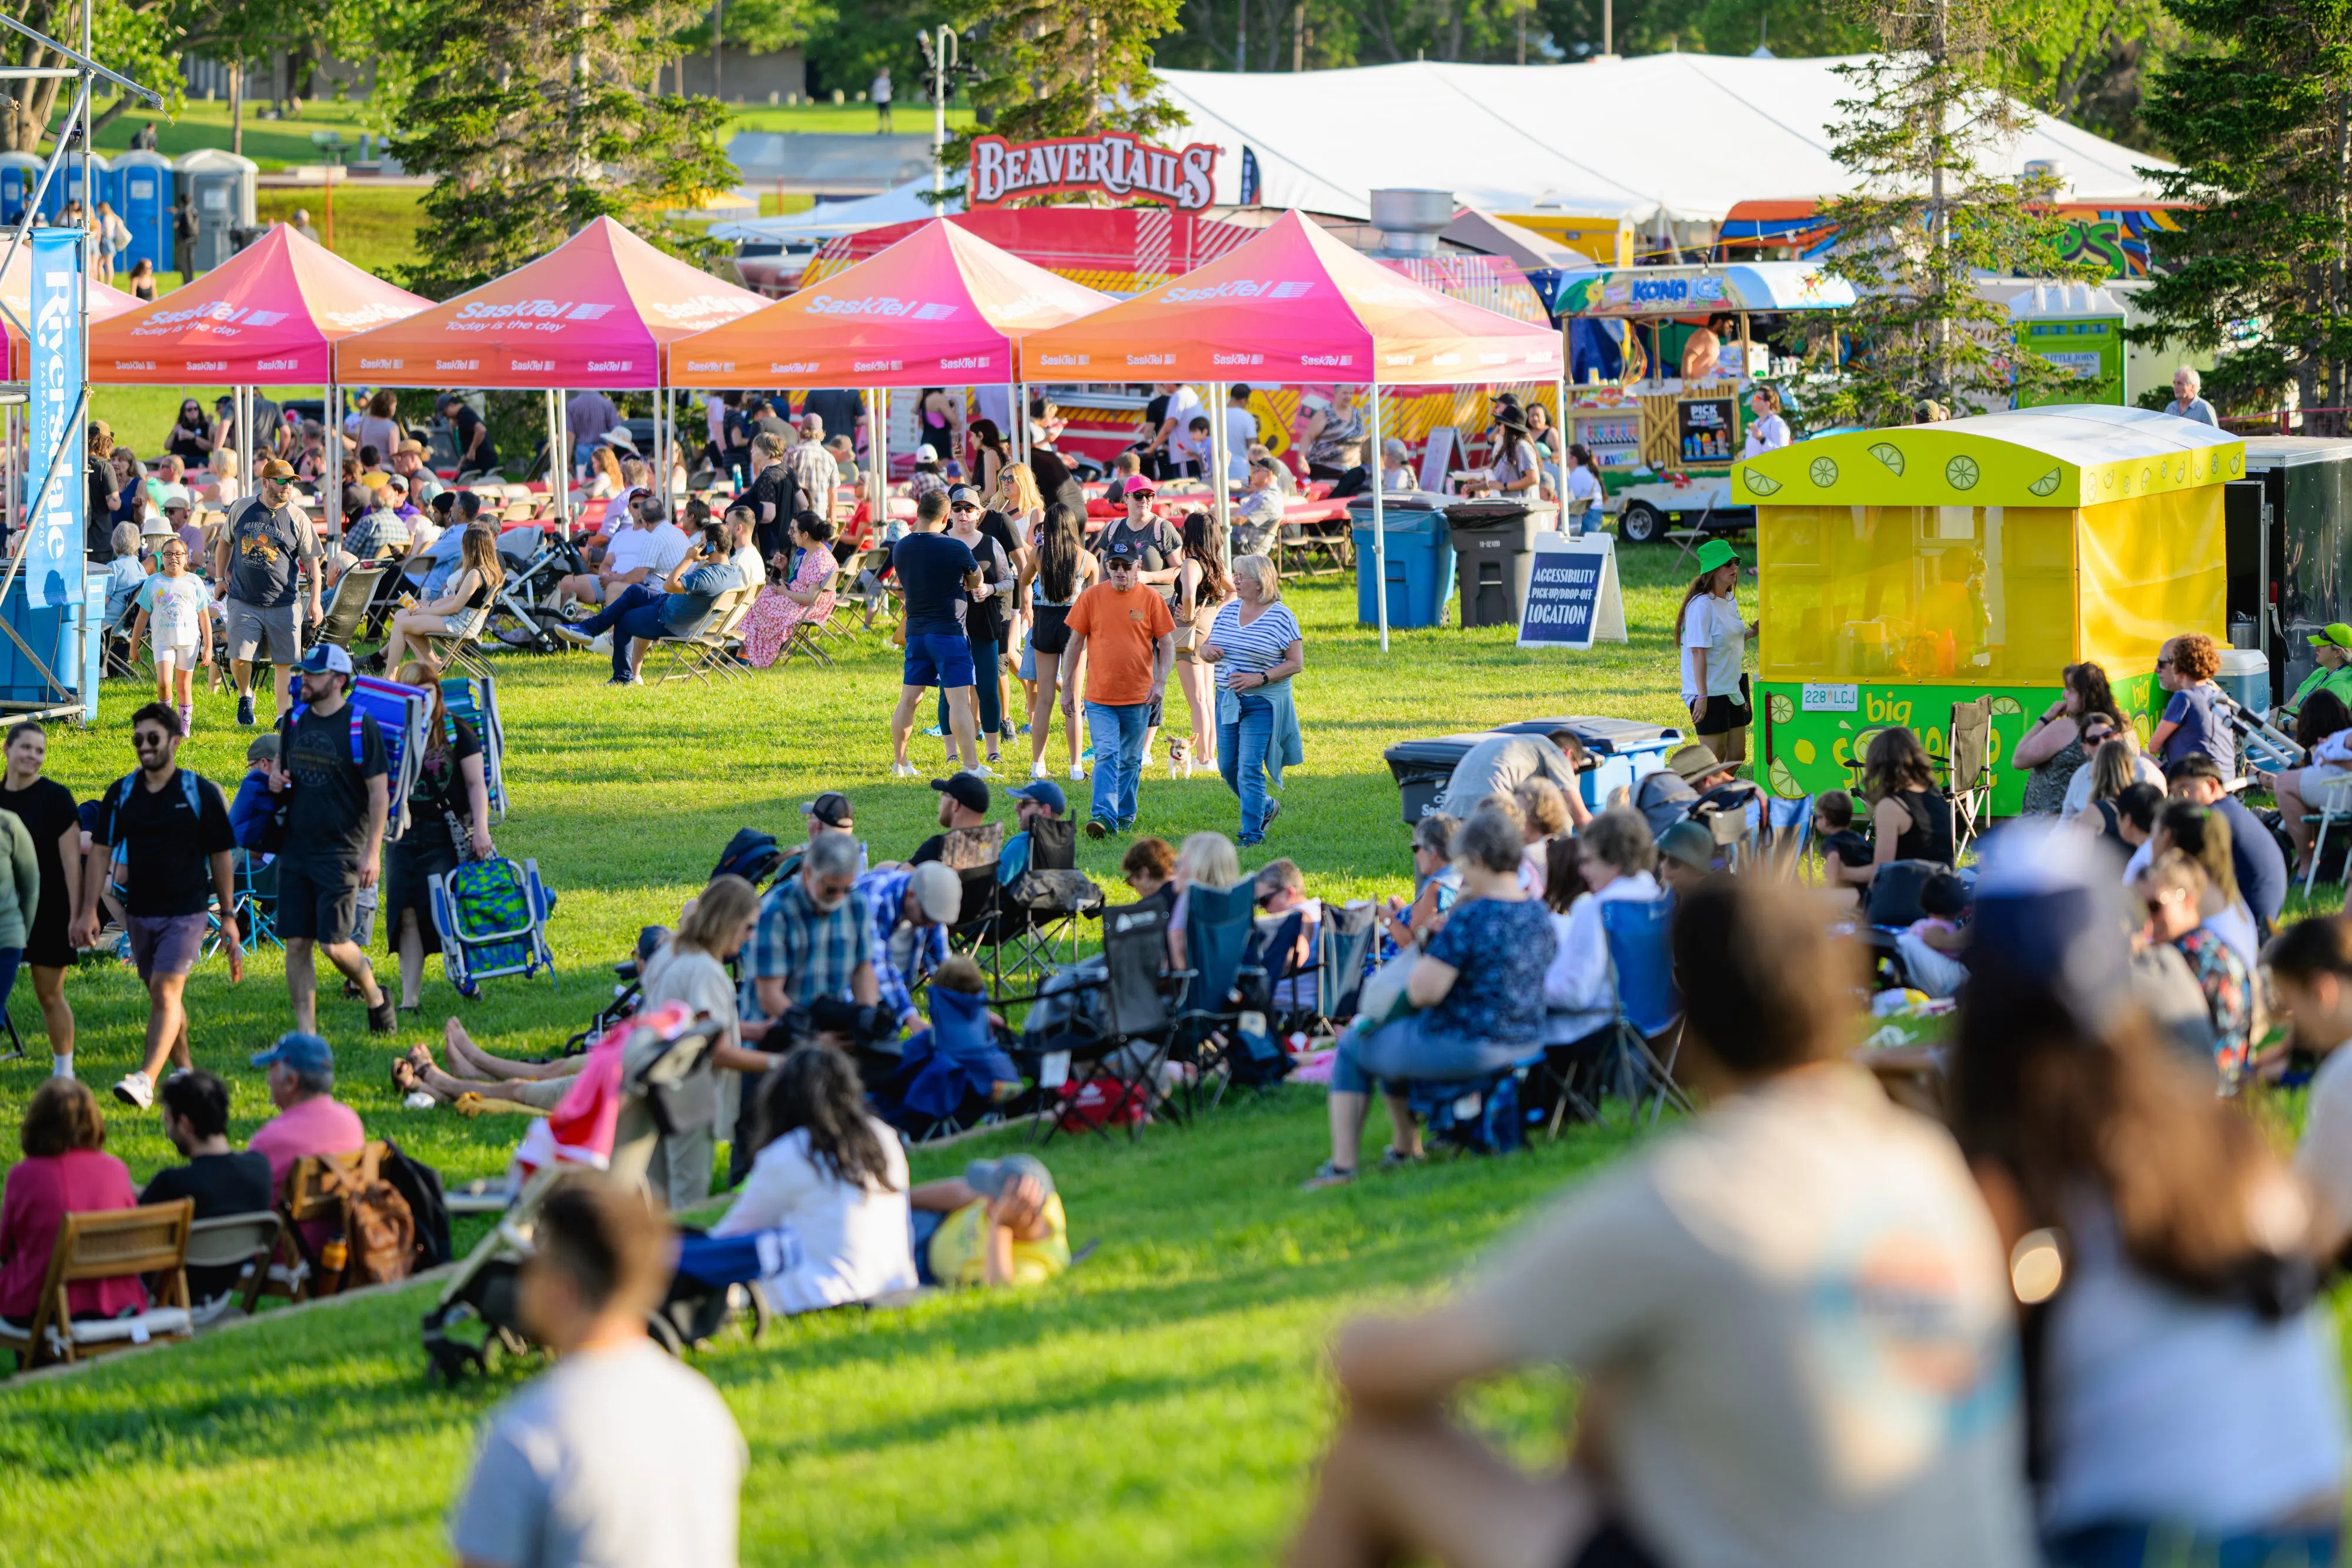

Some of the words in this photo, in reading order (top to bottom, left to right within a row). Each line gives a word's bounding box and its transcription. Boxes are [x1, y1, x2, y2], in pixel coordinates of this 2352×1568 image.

[1160, 280, 1273, 304] SaskTel
[1631, 279, 1688, 304] KONA
[1689, 277, 1724, 300] ICE
[456, 300, 573, 319] SaskTel
[805, 295, 918, 317] SaskTel
[142, 301, 249, 326] SaskTel
[130, 327, 171, 336] Today
[172, 324, 185, 333] is
[186, 321, 211, 332] the
[212, 325, 242, 337] day
[445, 322, 490, 333] Today
[491, 320, 505, 330] is
[507, 320, 533, 330] the
[534, 321, 566, 333] day
[115, 360, 145, 370] SaskTel
[186, 360, 216, 371] SaskTel
[257, 360, 288, 370] SaskTel
[360, 359, 392, 370] SaskTel
[436, 360, 467, 370] SaskTel
[512, 360, 543, 371] SaskTel
[941, 356, 977, 370] SaskTel
[1040, 355, 1077, 366] SaskTel
[1127, 354, 1162, 365] SaskTel
[1214, 353, 1250, 365] SaskTel
[1301, 355, 1339, 366] SaskTel
[587, 361, 620, 372] SaskTel
[687, 361, 723, 372] SaskTel
[771, 362, 806, 373] SaskTel
[854, 360, 889, 372] SaskTel
[36, 272, 74, 560] Riversdale
[1690, 405, 1718, 415] PICK
[1596, 450, 1636, 466] LAVORS
[243, 521, 265, 530] ORANGE
[265, 524, 285, 540] COUNTY
[1534, 568, 1596, 583] ACCESSIBILITY
[1531, 587, 1593, 602] PICK-UP/DROP-OFF
[1527, 604, 1588, 624] LOCATION
[1805, 690, 1826, 703] 228
[1834, 691, 1855, 704] LCJ
[2133, 677, 2150, 709] big
[1865, 691, 1912, 727] big
